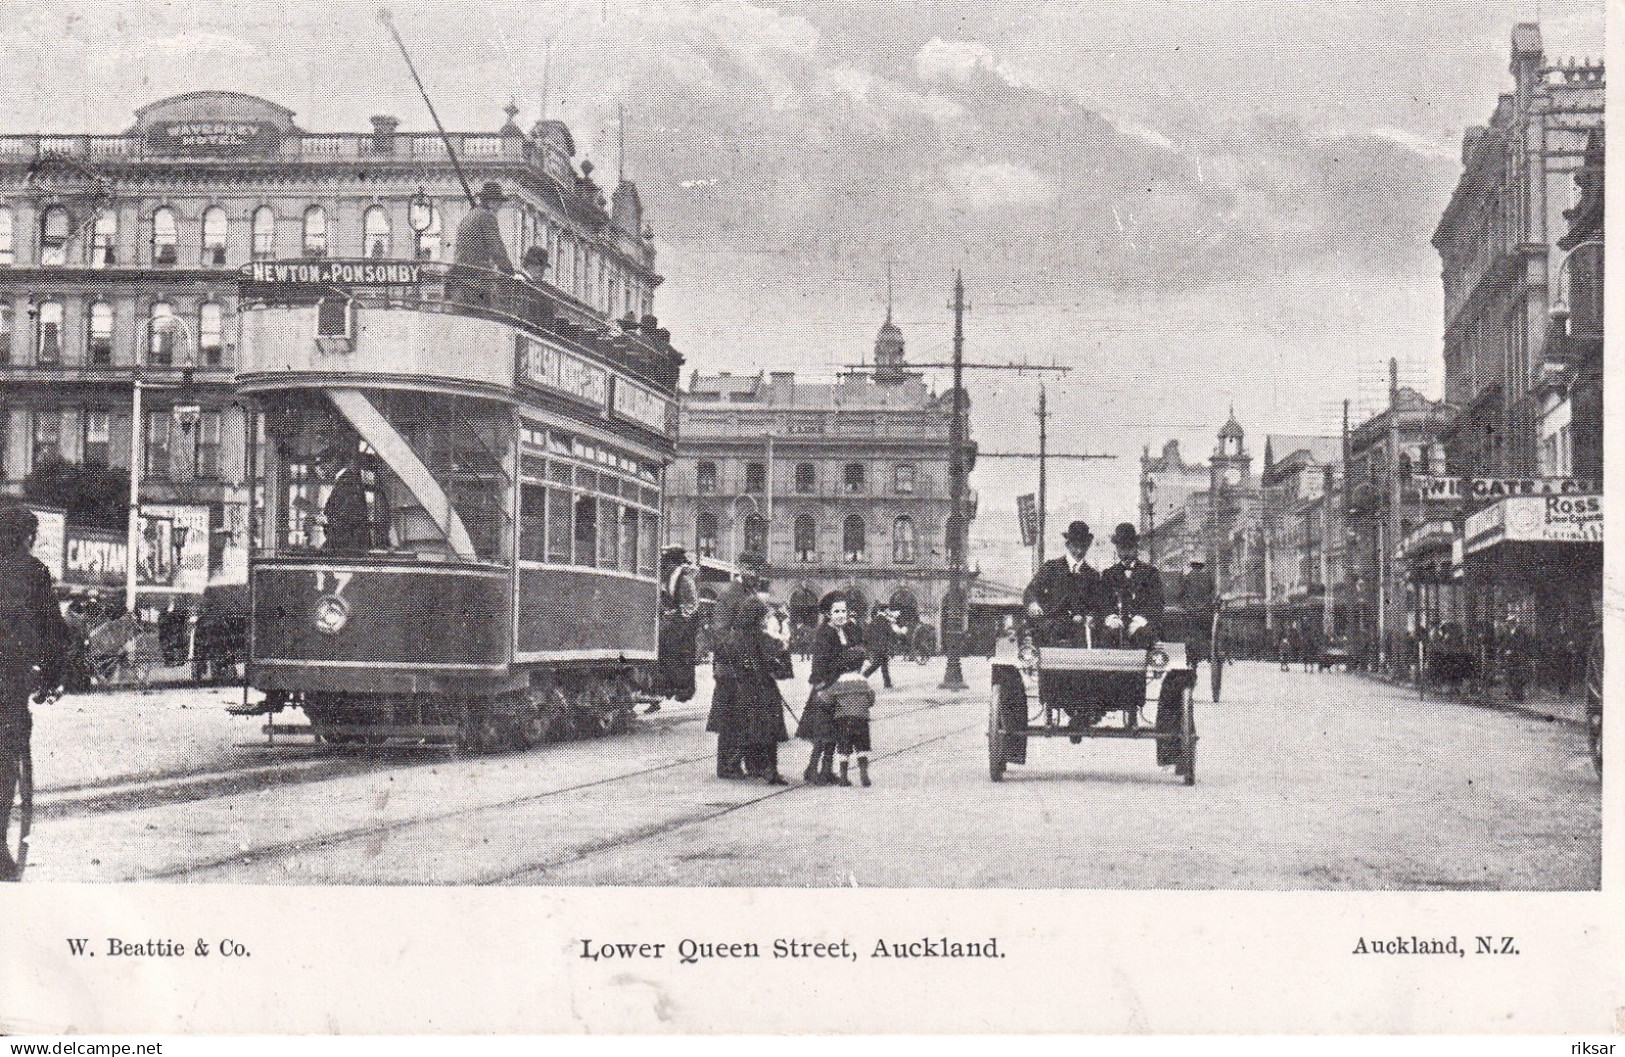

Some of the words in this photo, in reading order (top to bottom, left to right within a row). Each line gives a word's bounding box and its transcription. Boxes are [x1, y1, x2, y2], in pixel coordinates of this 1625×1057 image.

[166, 123, 260, 137] WAVERLEY
[182, 135, 247, 146] HOTEL
[253, 263, 320, 282] NEWTON
[331, 263, 420, 282] PONSONBY
[68, 539, 128, 572] CAPSTAN
[314, 572, 353, 595] 17
